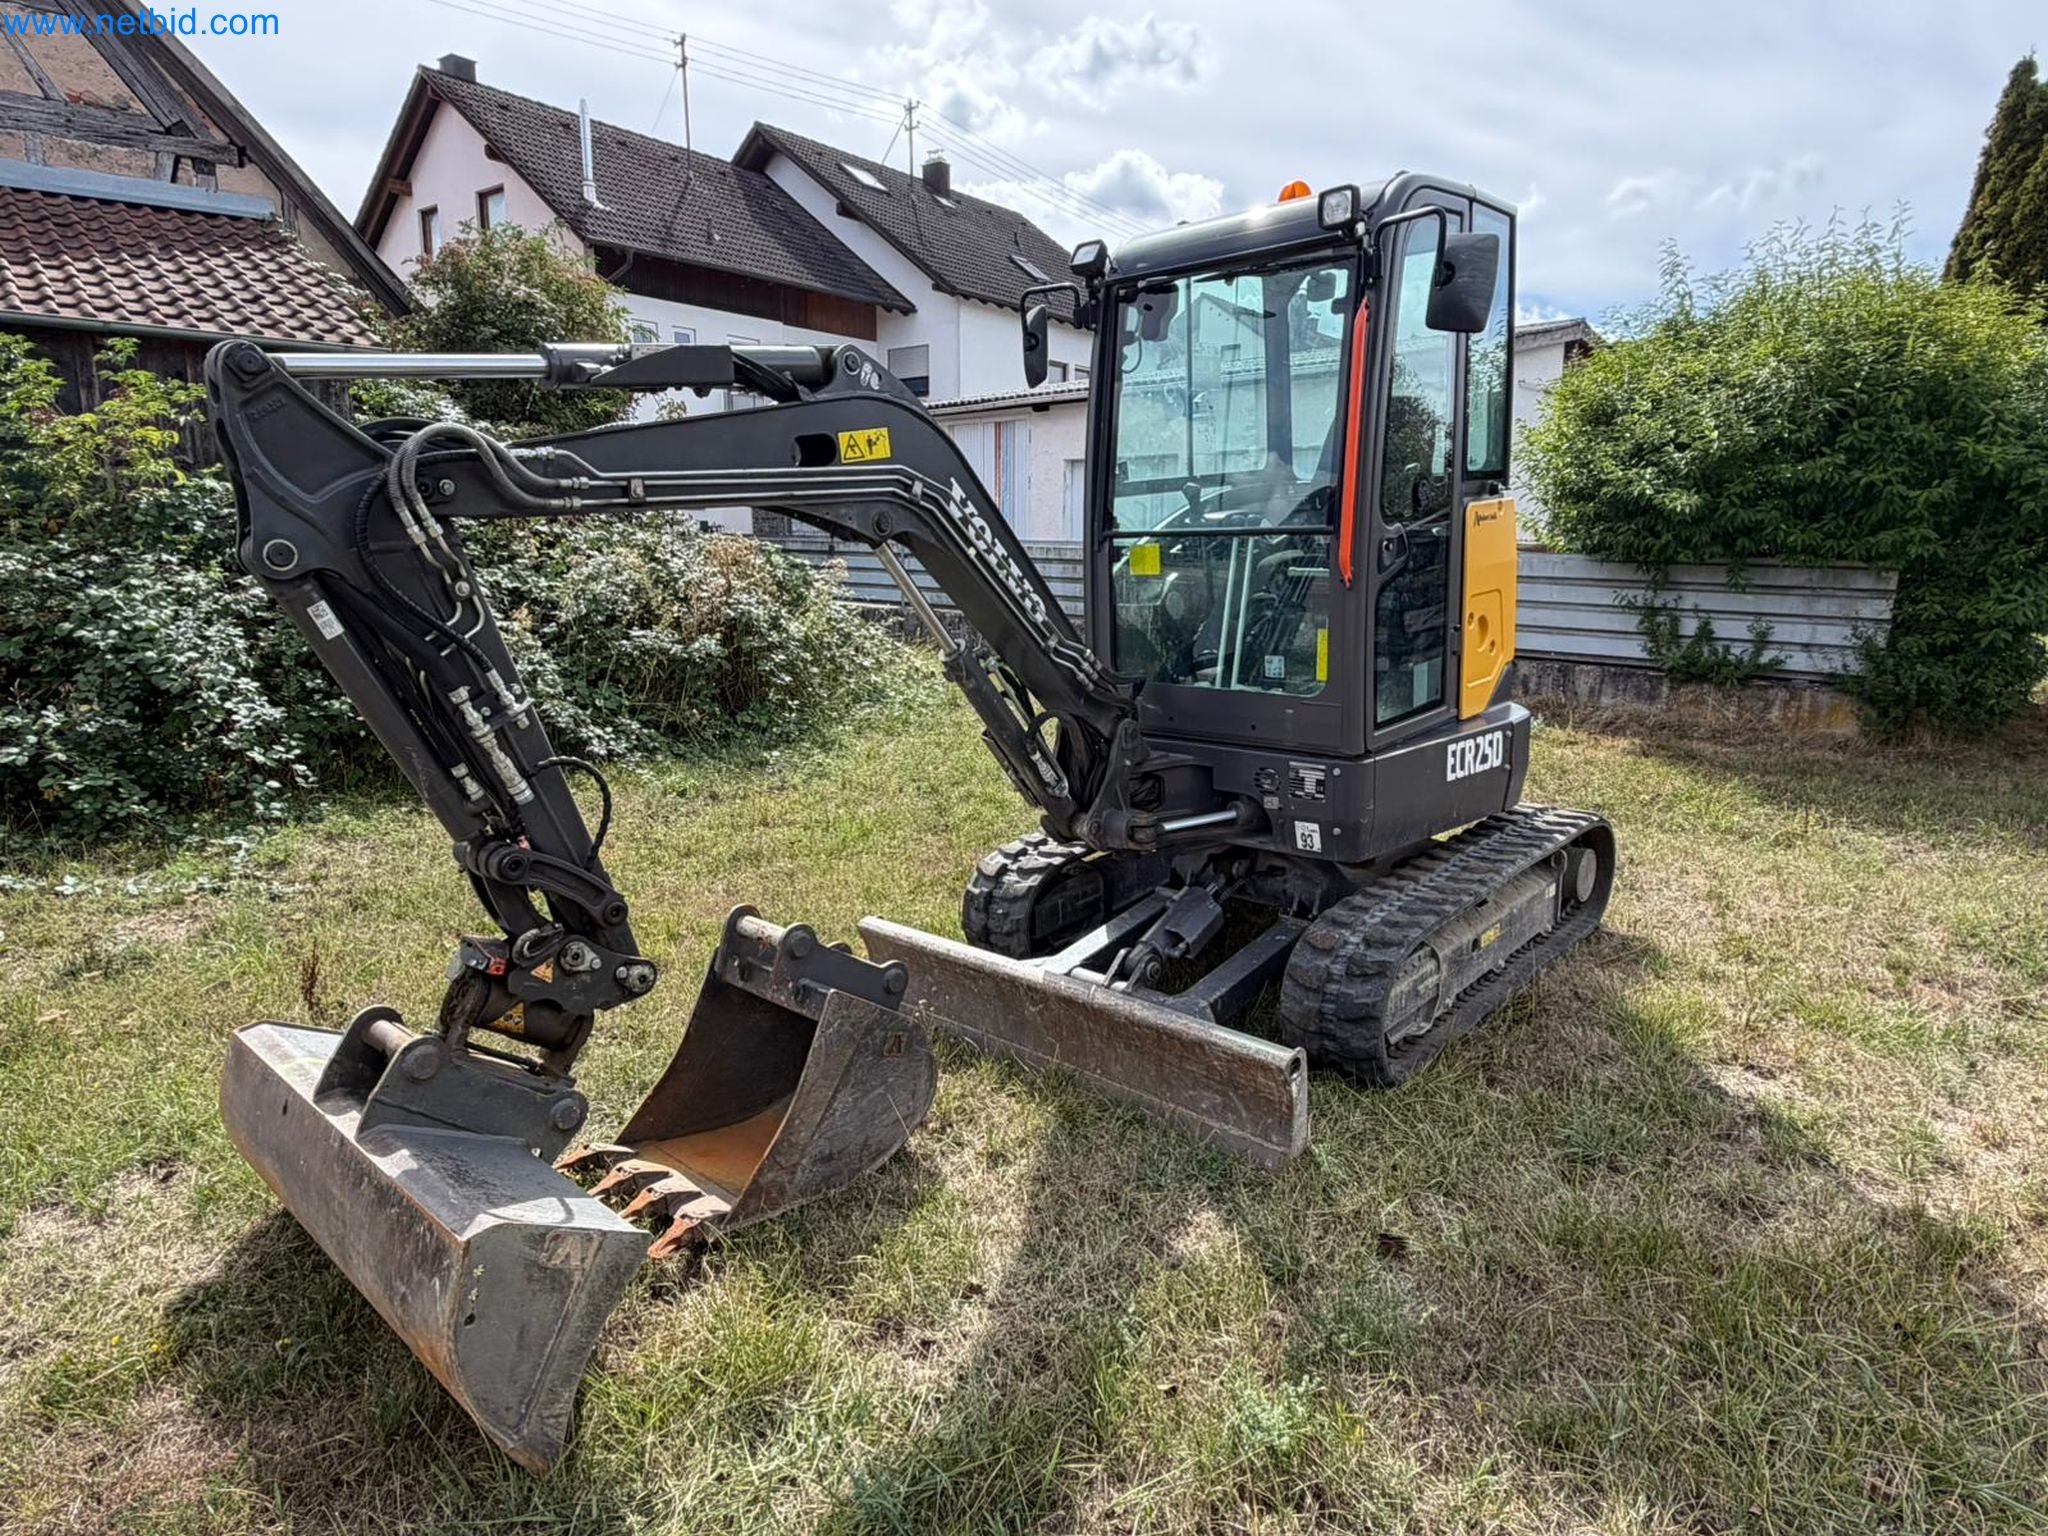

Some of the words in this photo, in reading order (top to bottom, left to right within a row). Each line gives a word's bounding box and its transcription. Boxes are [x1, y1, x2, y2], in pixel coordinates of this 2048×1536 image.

[949, 477, 1047, 624] VOLVO
[1446, 730, 1503, 782] ECR25D
[1300, 832, 1314, 850] 93
